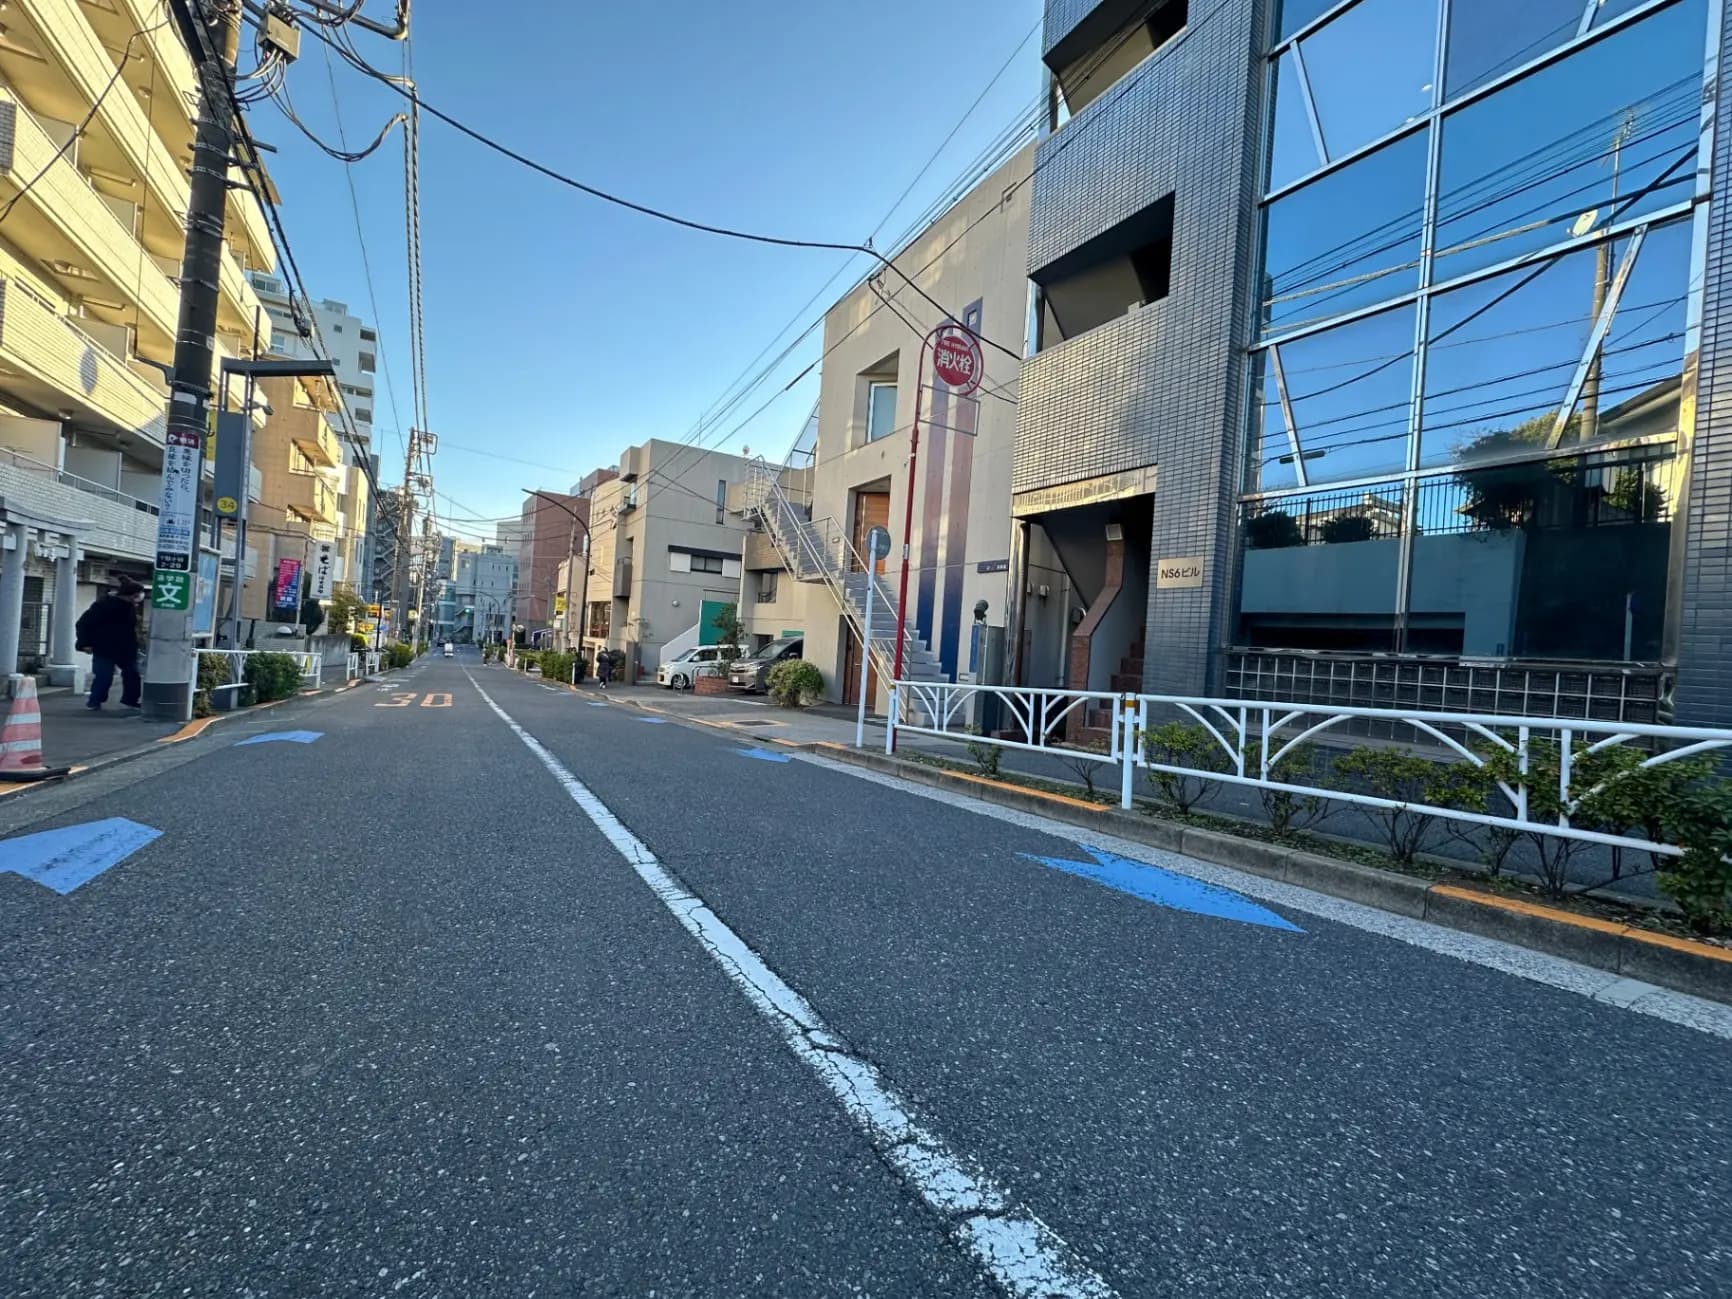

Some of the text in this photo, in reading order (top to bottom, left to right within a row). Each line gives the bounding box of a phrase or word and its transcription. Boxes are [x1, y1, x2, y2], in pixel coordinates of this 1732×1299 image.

[937, 347, 972, 375] 消火栓
[1161, 566, 1200, 579] NS6ビル
[156, 582, 182, 604] 文
[374, 692, 453, 707] 30
